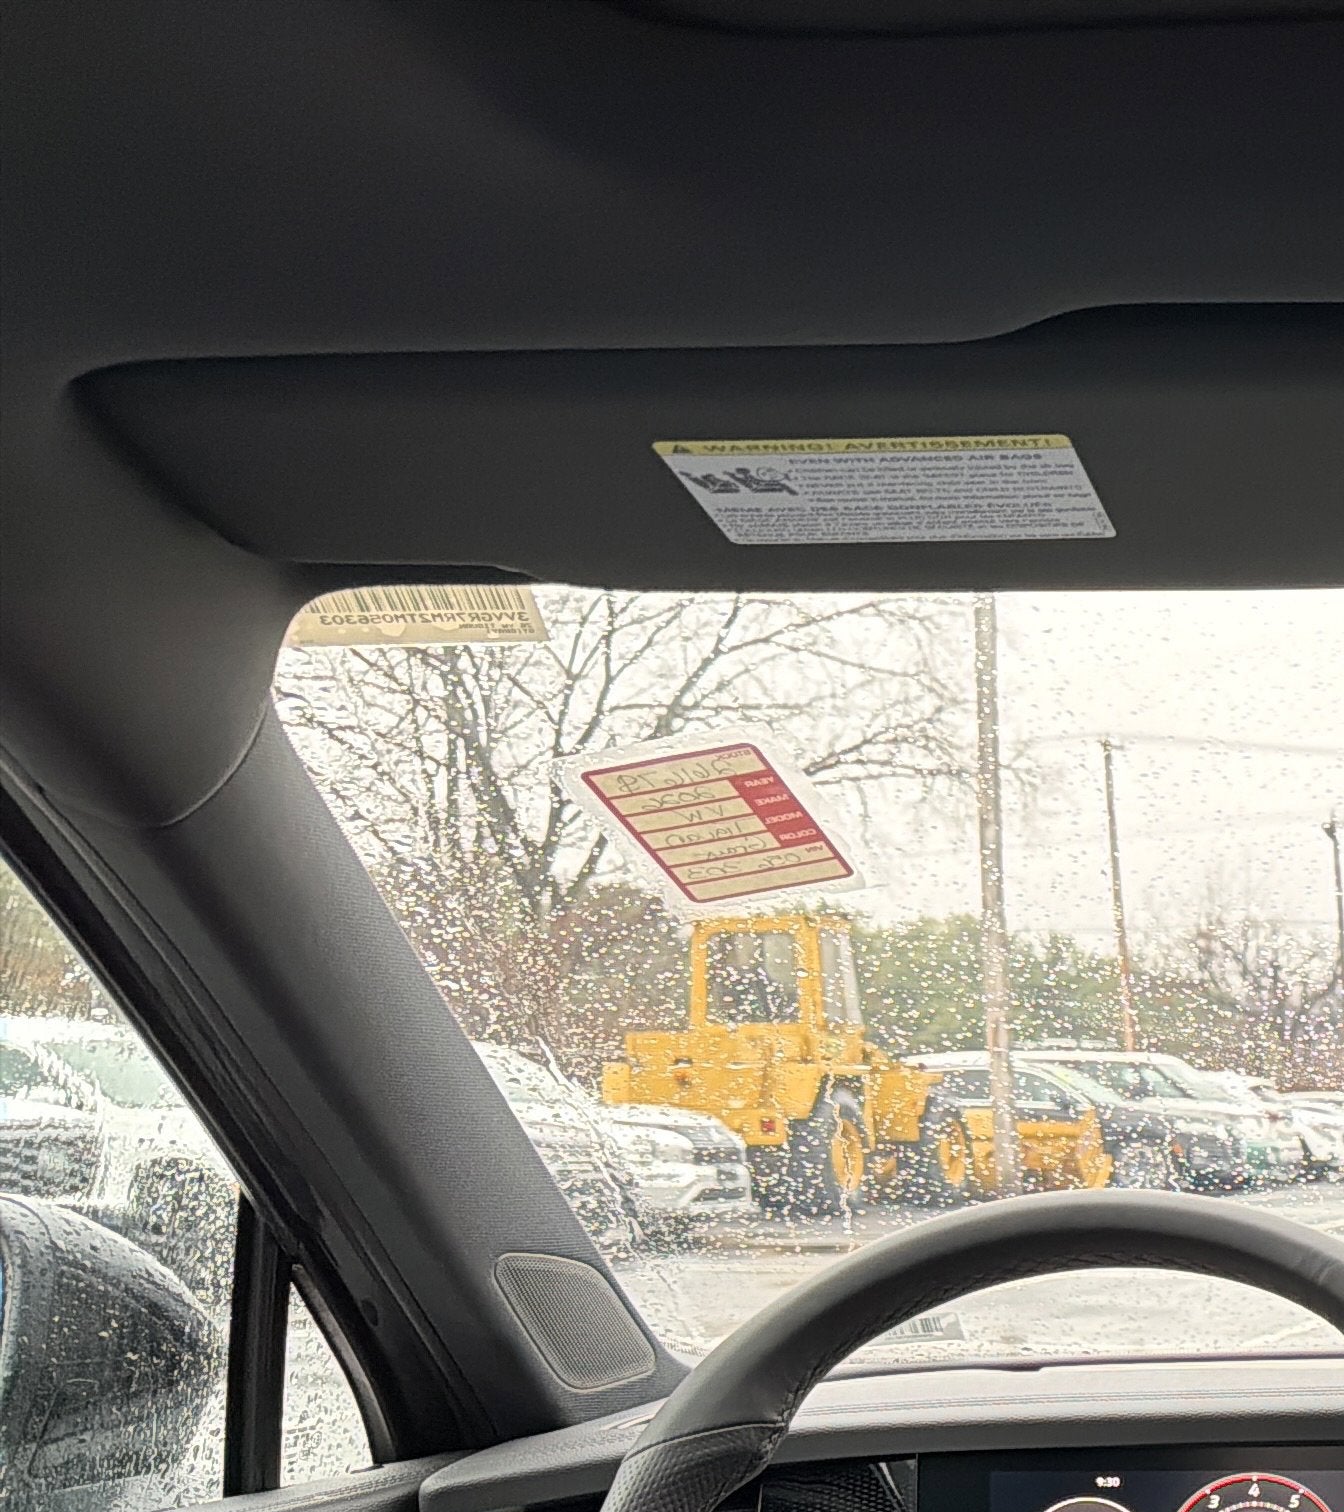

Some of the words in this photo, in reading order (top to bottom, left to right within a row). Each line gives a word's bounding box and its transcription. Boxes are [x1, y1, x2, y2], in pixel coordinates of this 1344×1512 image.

[703, 443, 832, 452] WARNING!
[845, 438, 1050, 450] AVERTISSEMENT!
[1096, 1477, 1120, 1488] 9:30
[1248, 1484, 1260, 1497] 4
[1208, 1495, 1220, 1508] 3
[1290, 1495, 1300, 1508] 5
